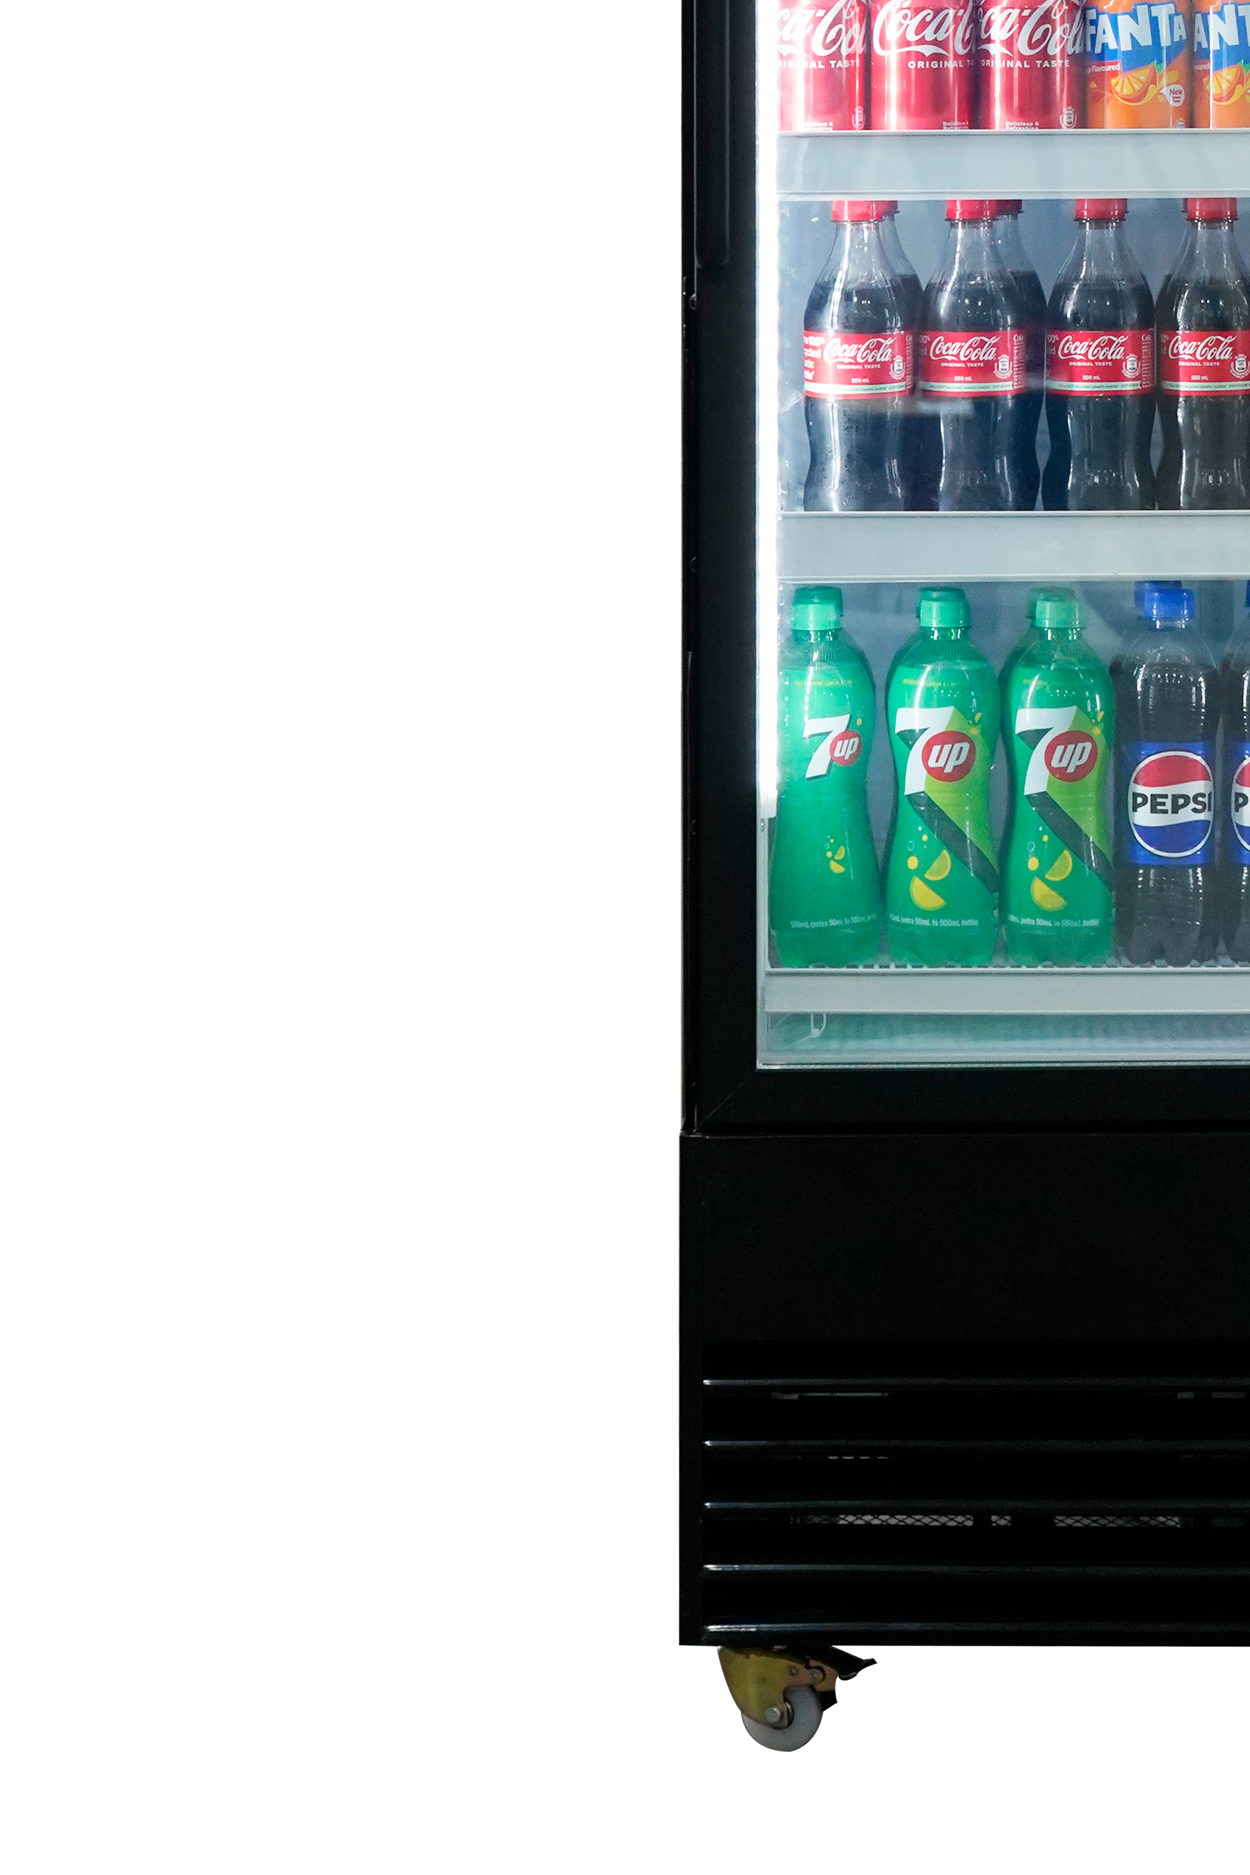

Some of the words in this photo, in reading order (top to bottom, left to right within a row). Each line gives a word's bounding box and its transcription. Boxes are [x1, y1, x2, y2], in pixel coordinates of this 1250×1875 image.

[1086, 3, 1187, 54] FANTA
[908, 60, 964, 69] ORIGINAL
[1036, 60, 1070, 68] TASTE
[1091, 62, 1121, 72] Flavoured
[1169, 87, 1183, 96] New
[823, 336, 897, 363] Coca-Cola
[930, 335, 1000, 362] Coca-Cola
[1058, 335, 1129, 360] Coca-Cola
[1168, 335, 1237, 360] Coca-Cola
[1132, 791, 1212, 815] PEPSI
